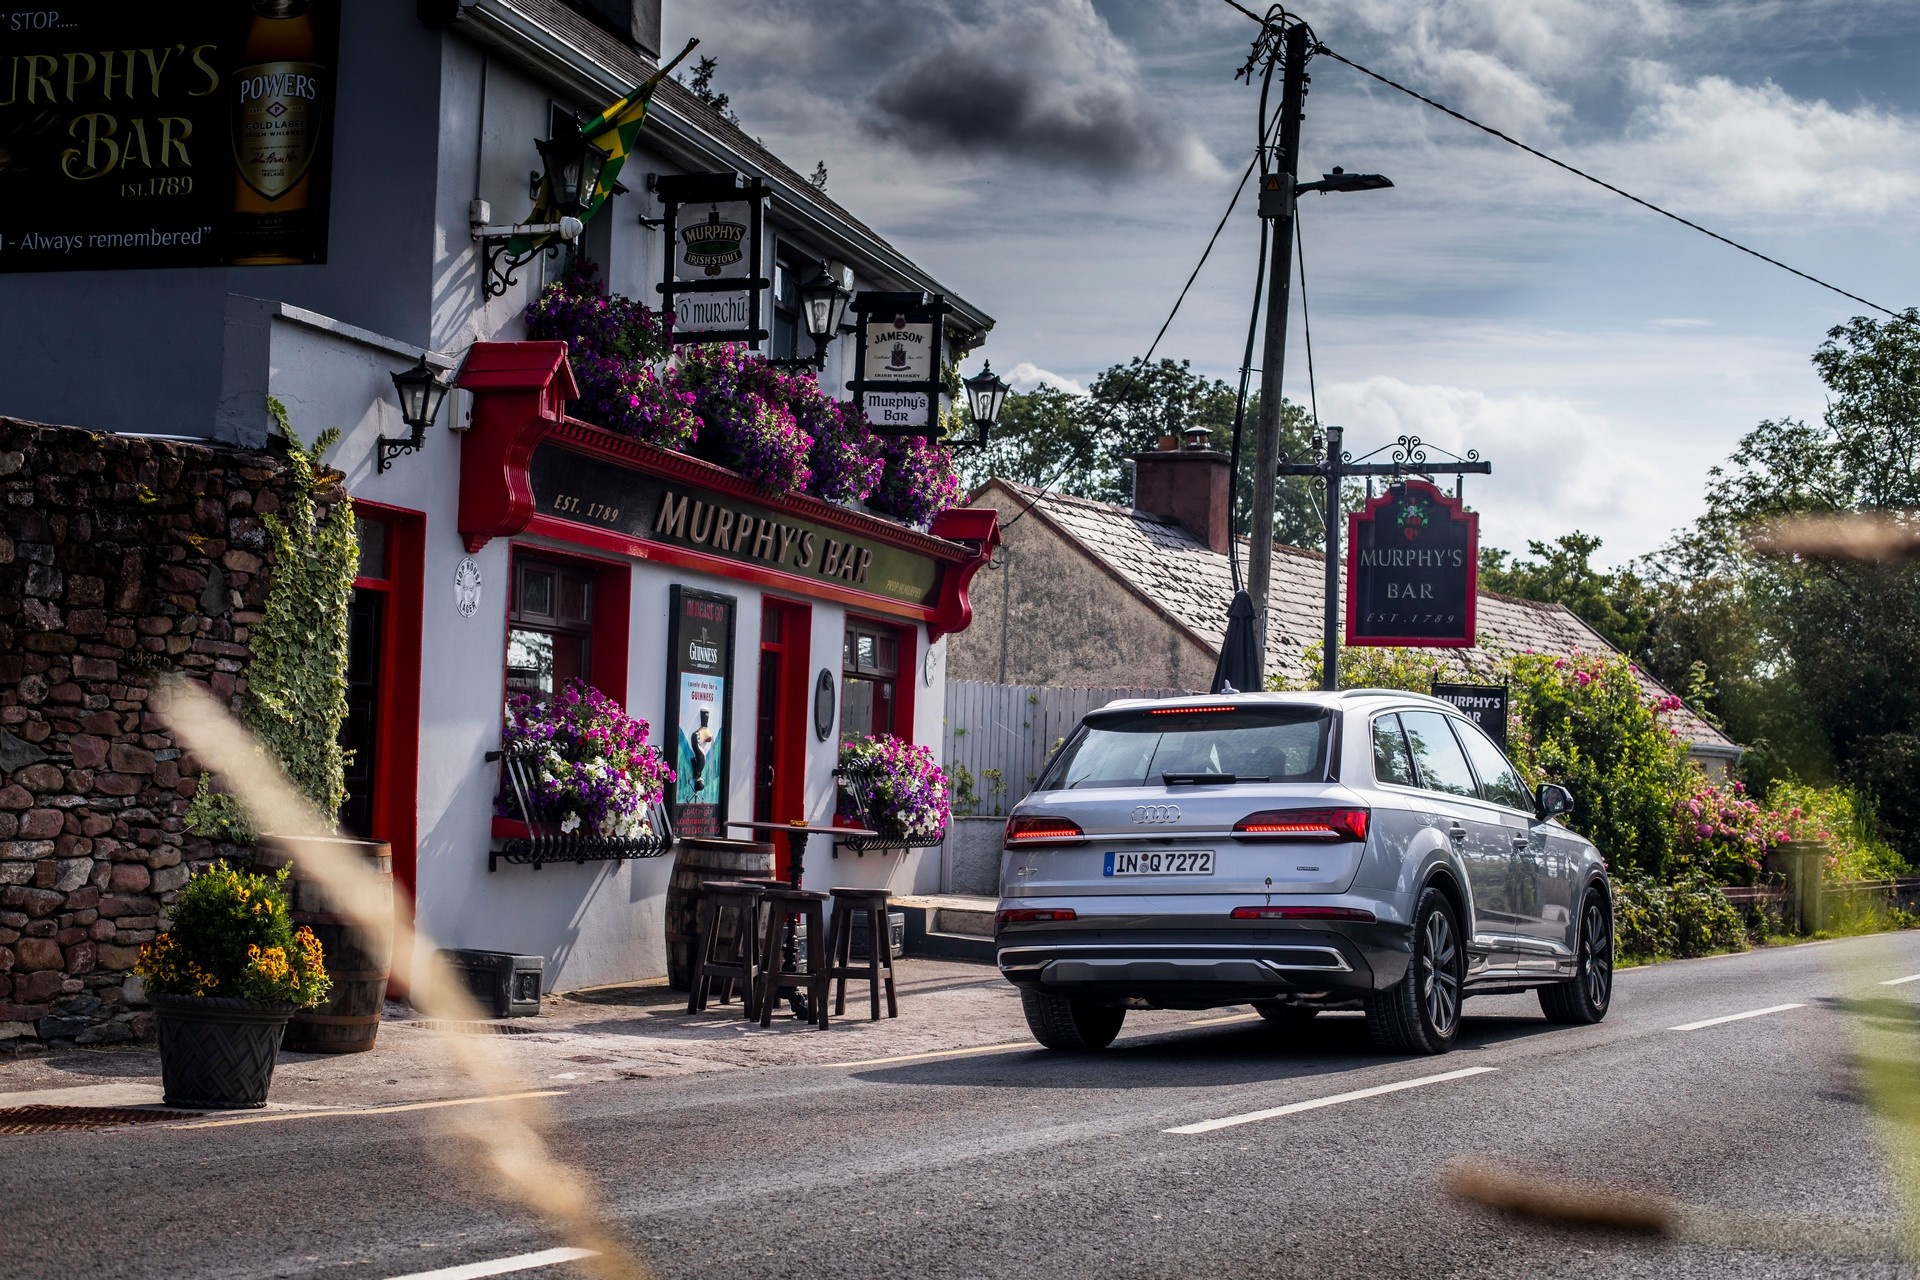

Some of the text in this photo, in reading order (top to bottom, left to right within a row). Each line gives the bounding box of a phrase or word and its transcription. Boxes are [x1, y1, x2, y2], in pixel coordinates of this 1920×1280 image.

[240, 72, 316, 104] POWERS
[246, 120, 305, 130] GOLD LABEL
[61, 112, 193, 181] BAR
[20, 232, 83, 254] Always
[685, 224, 743, 243] MURPHY'S
[687, 251, 739, 265] IRISH STOUT
[874, 331, 923, 345] JAMESON
[868, 395, 926, 411] Murphy's
[553, 494, 619, 523] EST. 1789
[655, 491, 874, 584] MURPHY'S BAR
[1360, 548, 1463, 568] MURPHY'S
[1387, 583, 1434, 600] BAR
[689, 642, 718, 664] GUINNESS
[691, 691, 714, 702] GUINNESS
[1437, 694, 1501, 709] MURPHY'S
[1461, 711, 1482, 723] AR
[1116, 853, 1211, 873] IN Q 7272
